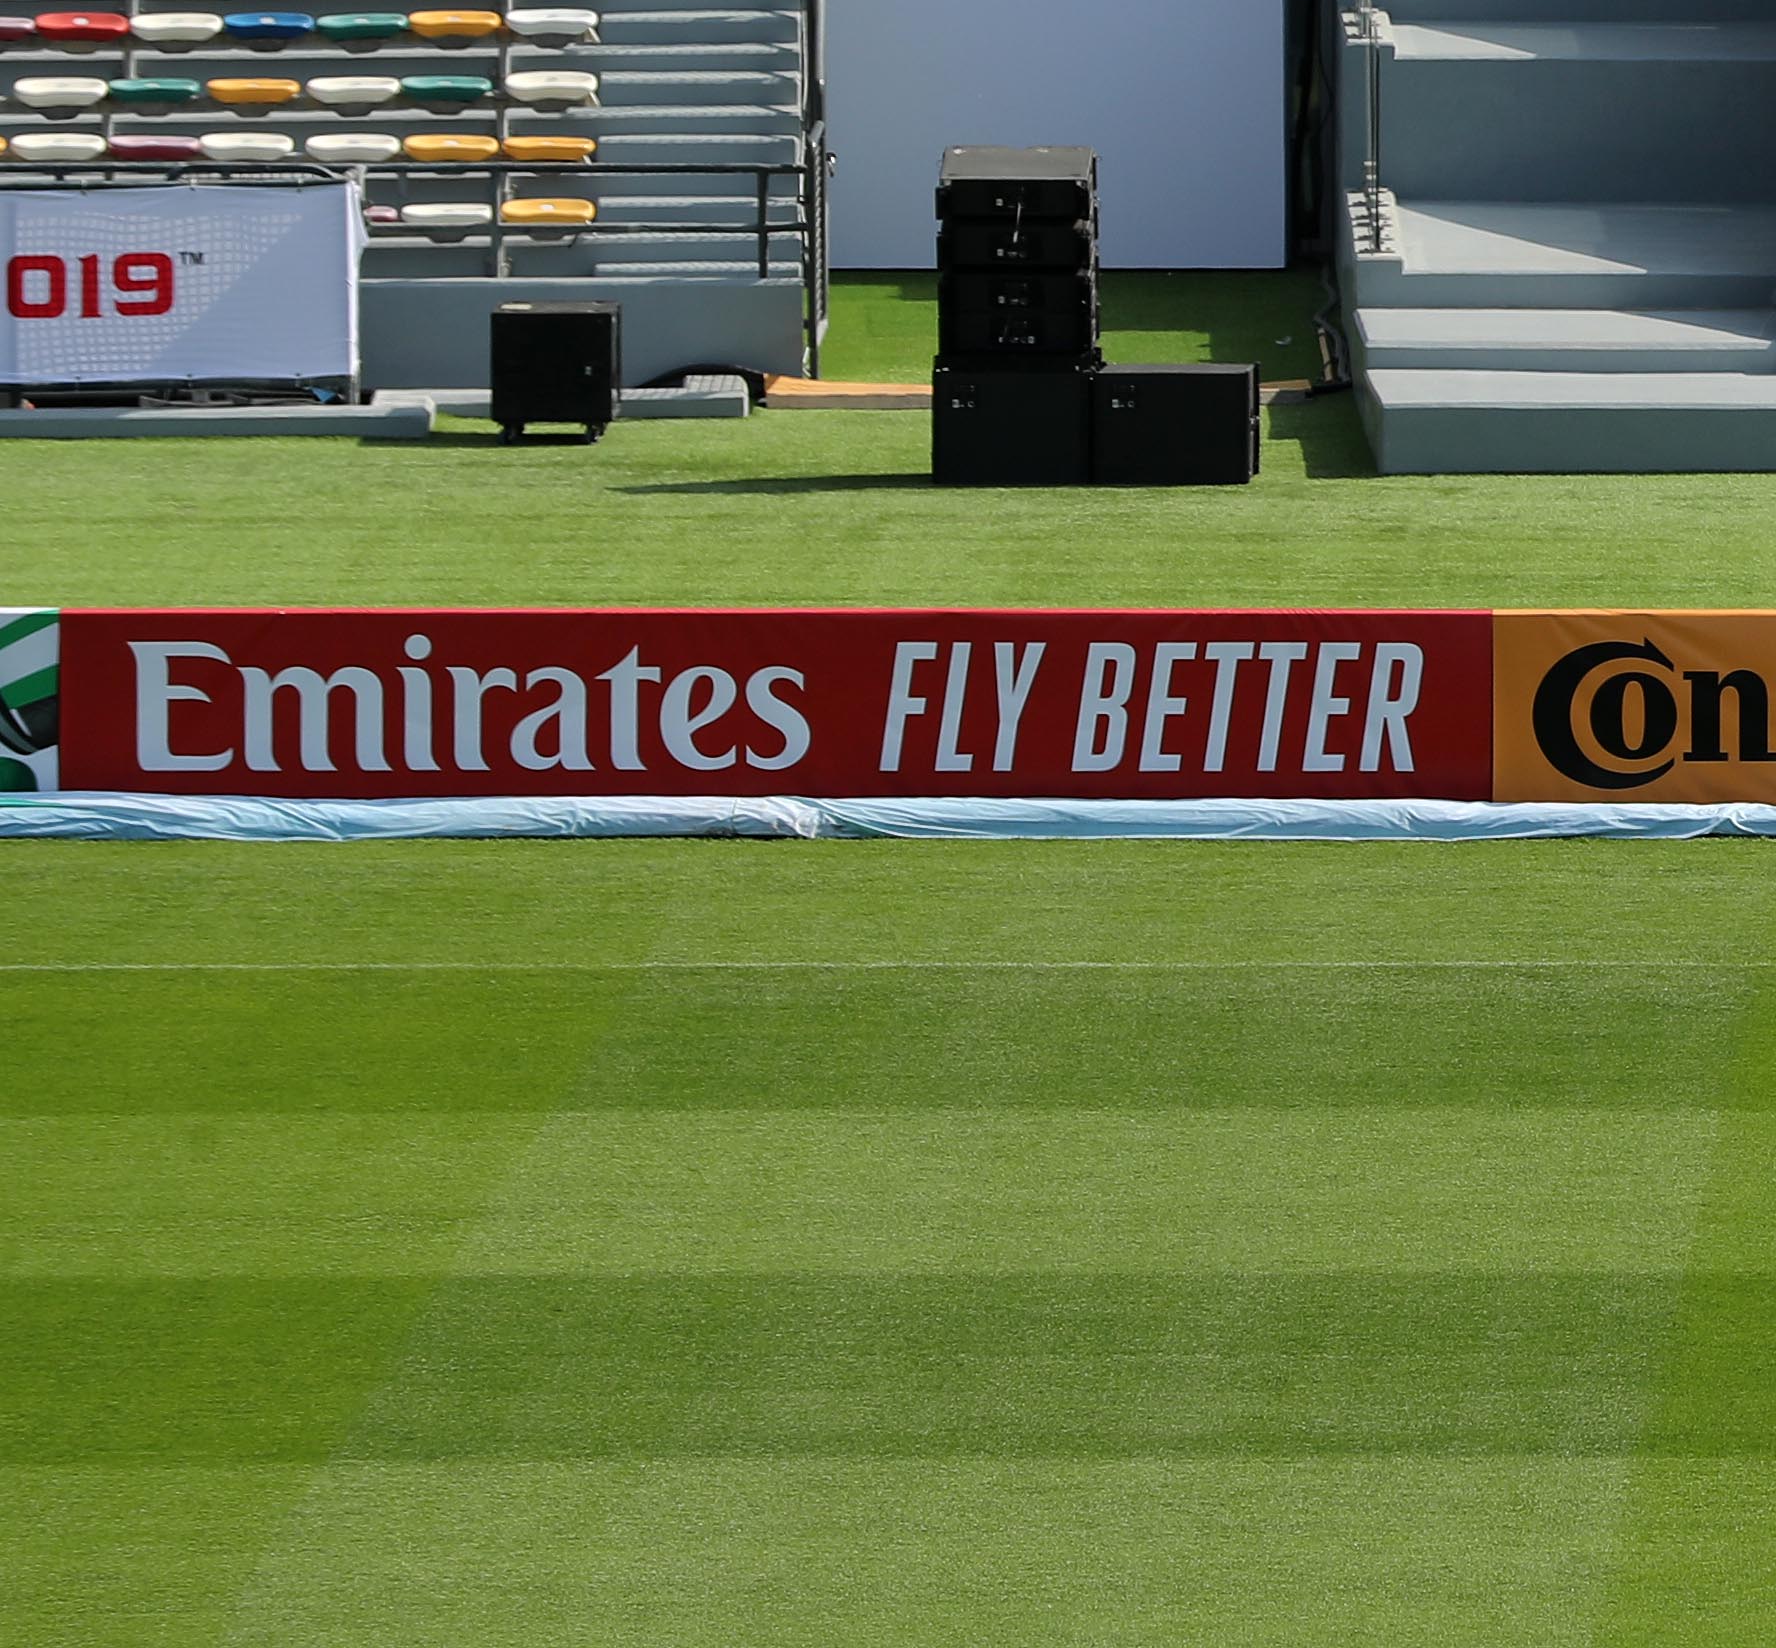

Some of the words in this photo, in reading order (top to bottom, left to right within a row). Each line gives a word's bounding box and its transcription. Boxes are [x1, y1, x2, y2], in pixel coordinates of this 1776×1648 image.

[127, 634, 811, 771] Emirates
[879, 641, 1047, 772] FLY
[1071, 641, 1424, 772] BETTER
